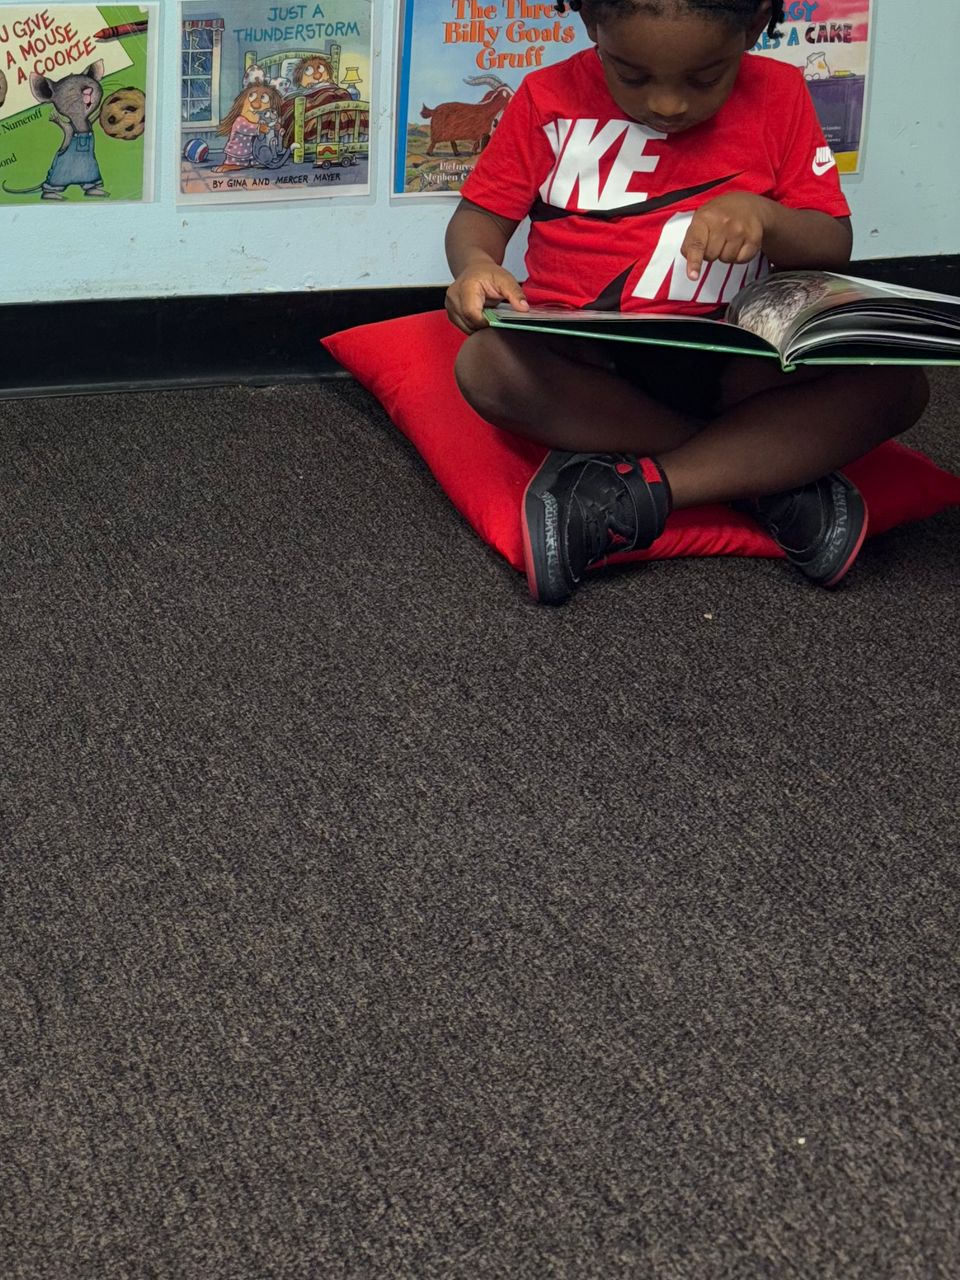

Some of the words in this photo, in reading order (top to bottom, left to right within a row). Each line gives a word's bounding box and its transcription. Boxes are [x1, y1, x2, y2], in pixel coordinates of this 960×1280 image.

[12, 9, 55, 38] GIVE
[267, 5, 307, 22] JUST
[312, 3, 324, 18] A
[233, 21, 360, 43] THUNDERSTORM
[442, 20, 503, 48] Billy
[505, 20, 575, 44] Goats
[787, 27, 800, 46] A
[805, 23, 853, 44] CAKE
[6, 51, 16, 70] A
[19, 22, 78, 61] MOUSE
[476, 45, 545, 70] Gruff
[17, 67, 28, 85] A
[33, 36, 97, 77] COOKIE
[1, 108, 43, 134] Numeroff
[816, 146, 835, 163] NIK
[212, 180, 223, 189] BY
[227, 178, 247, 188] GINA
[251, 177, 270, 186] AND
[274, 175, 309, 185] MERCER
[313, 172, 341, 182] MAYER
